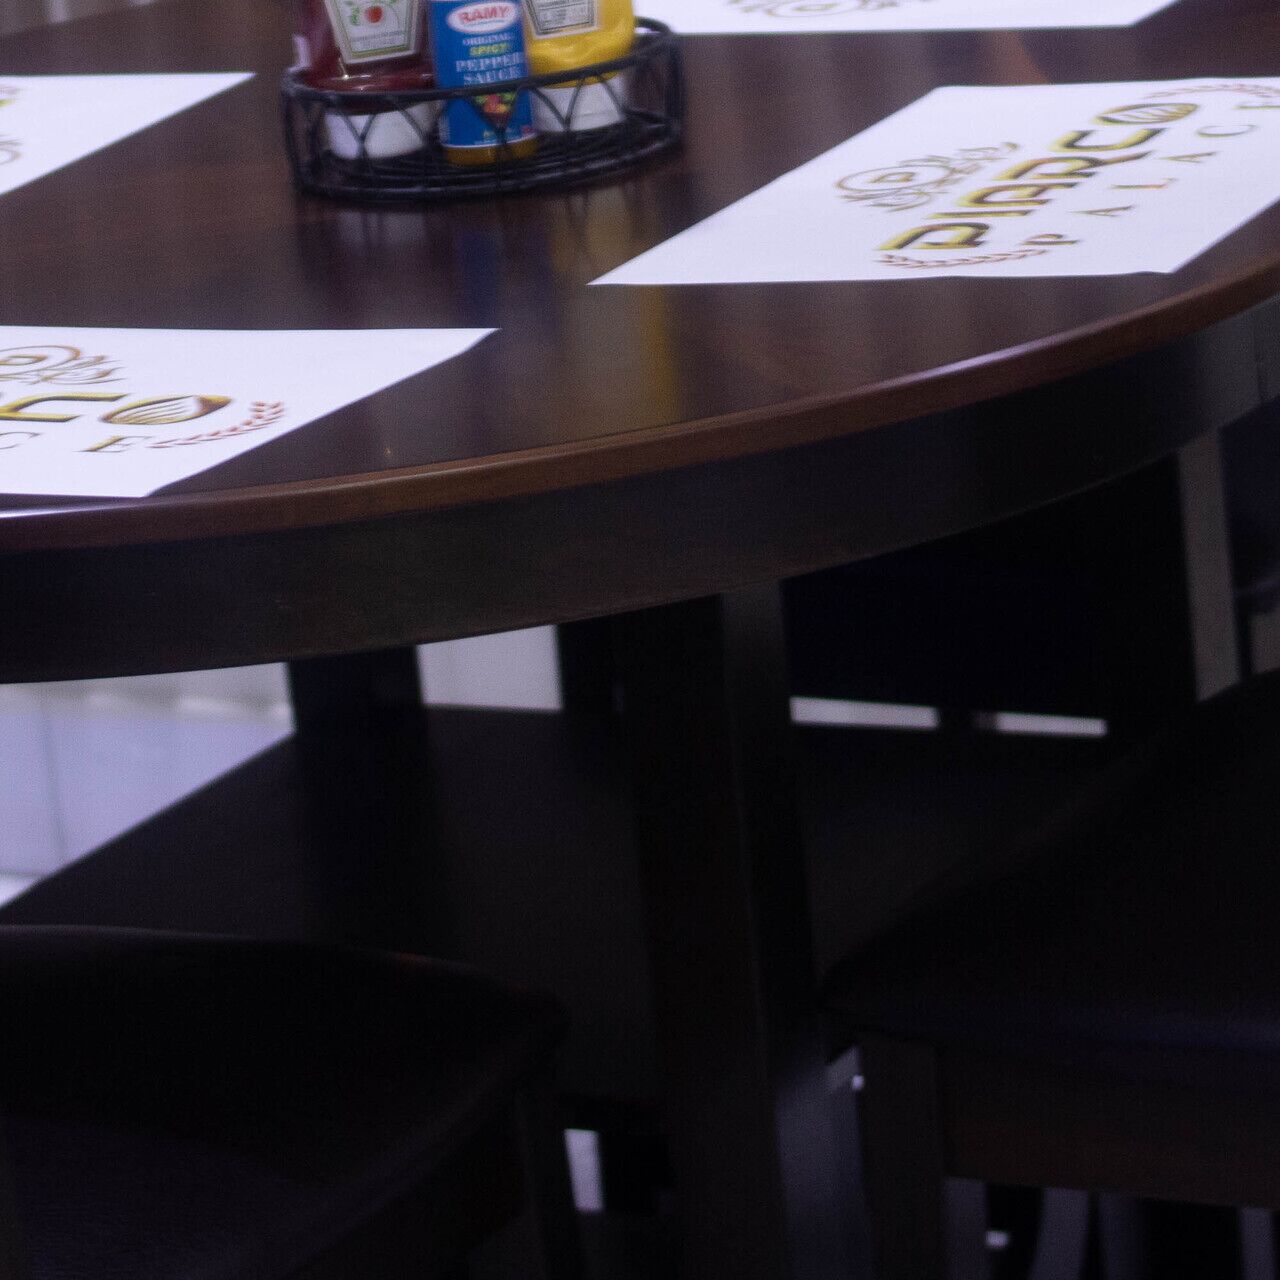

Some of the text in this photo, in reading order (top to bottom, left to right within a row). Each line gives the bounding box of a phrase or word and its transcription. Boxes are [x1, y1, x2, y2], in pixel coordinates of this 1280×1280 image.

[457, 6, 509, 26] RAMY
[463, 35, 510, 46] ORIGINAL
[469, 44, 506, 57] SPICY
[456, 53, 521, 73] PEPPER
[464, 68, 519, 86] SAUCE
[873, 101, 1202, 252] PIARCO
